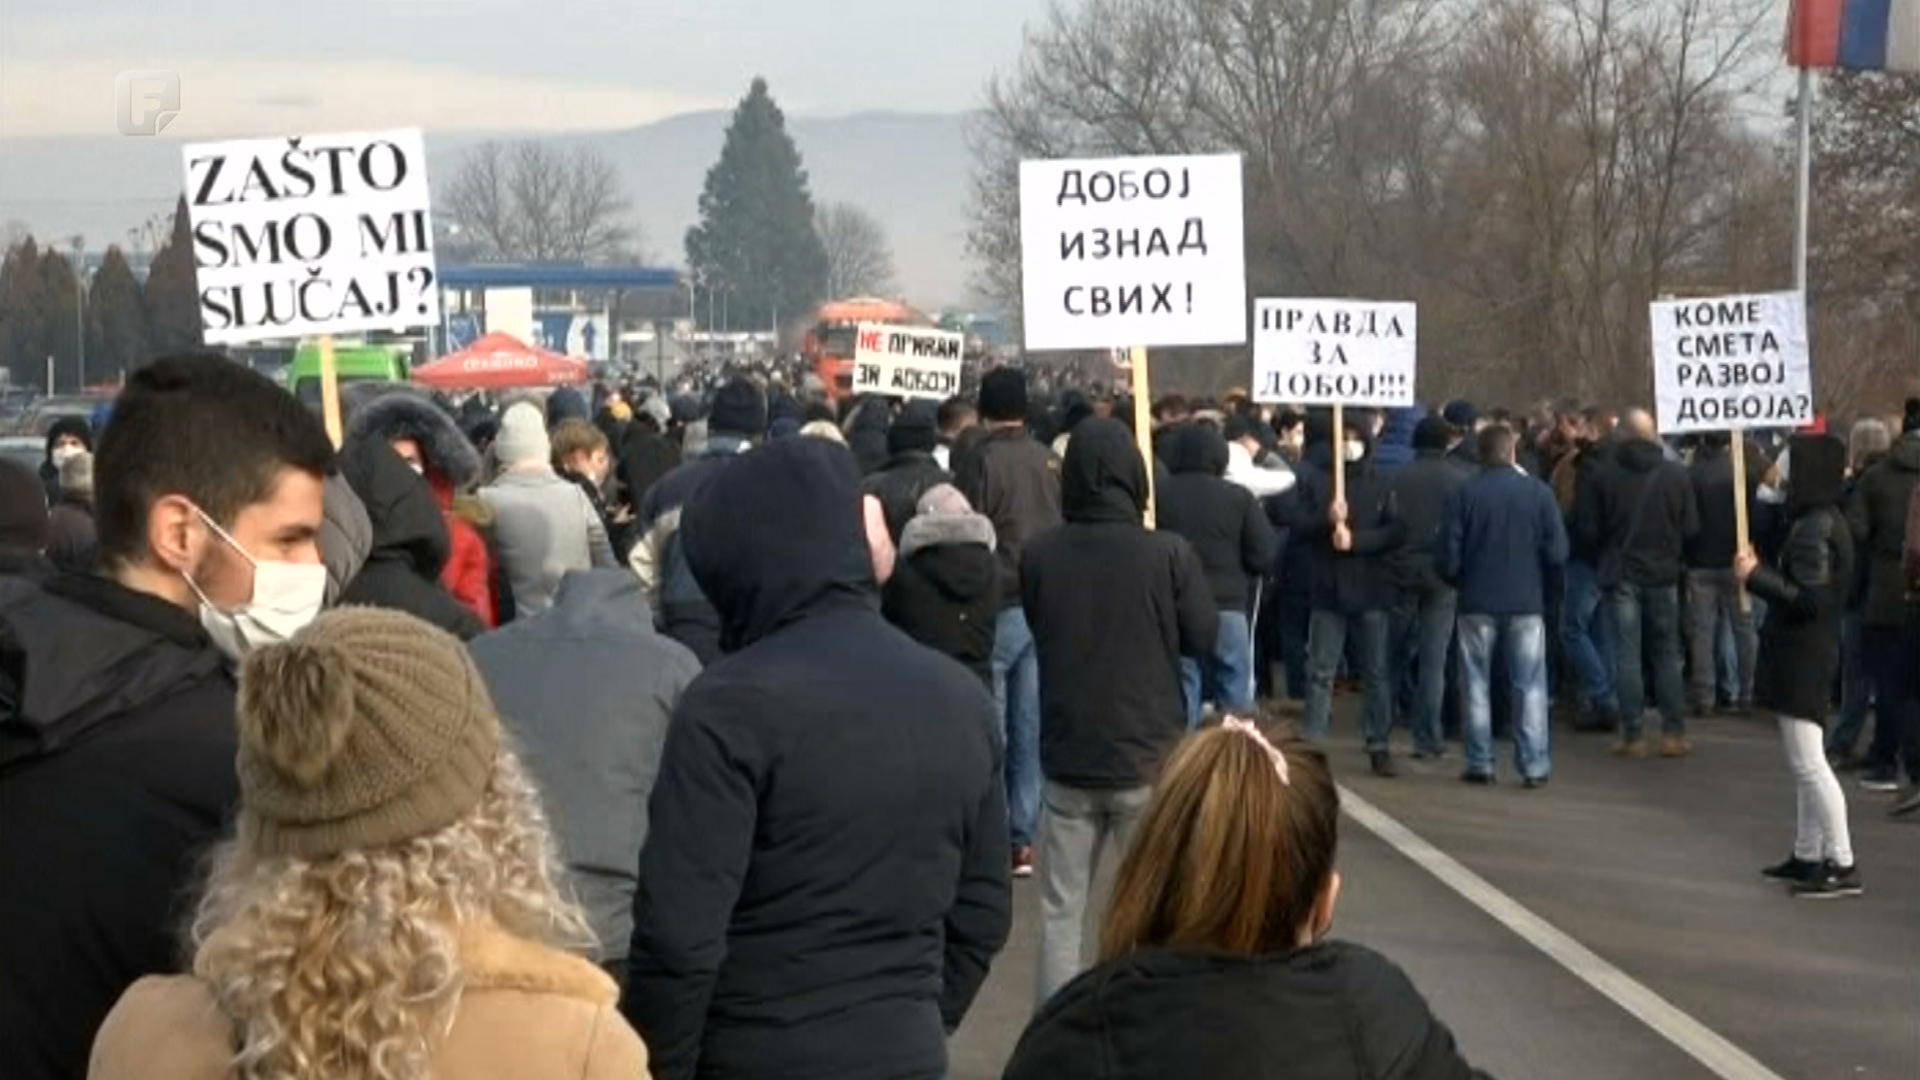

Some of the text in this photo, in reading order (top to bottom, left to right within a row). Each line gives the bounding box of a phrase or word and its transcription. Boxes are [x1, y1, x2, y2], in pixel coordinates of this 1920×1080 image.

[190, 136, 408, 206] ZAŠTO
[1056, 166, 1191, 207] ДОБОЈ
[193, 209, 430, 268] SMO MI
[1060, 216, 1208, 261] ИЗНАД
[200, 266, 434, 330] SLUČAJ?
[1063, 280, 1193, 317] СВИХ!
[1261, 307, 1405, 338] ПРАВДА
[1674, 300, 1761, 328] КОМЕ
[1309, 340, 1349, 365] ЗА
[1677, 330, 1780, 357] СМЕТА
[856, 363, 881, 387] ЗА
[1260, 370, 1406, 398] ДОБОЈ!!!
[1677, 360, 1785, 387] РАЗВОЈ
[1676, 394, 1810, 423] ДОБОЈА?
